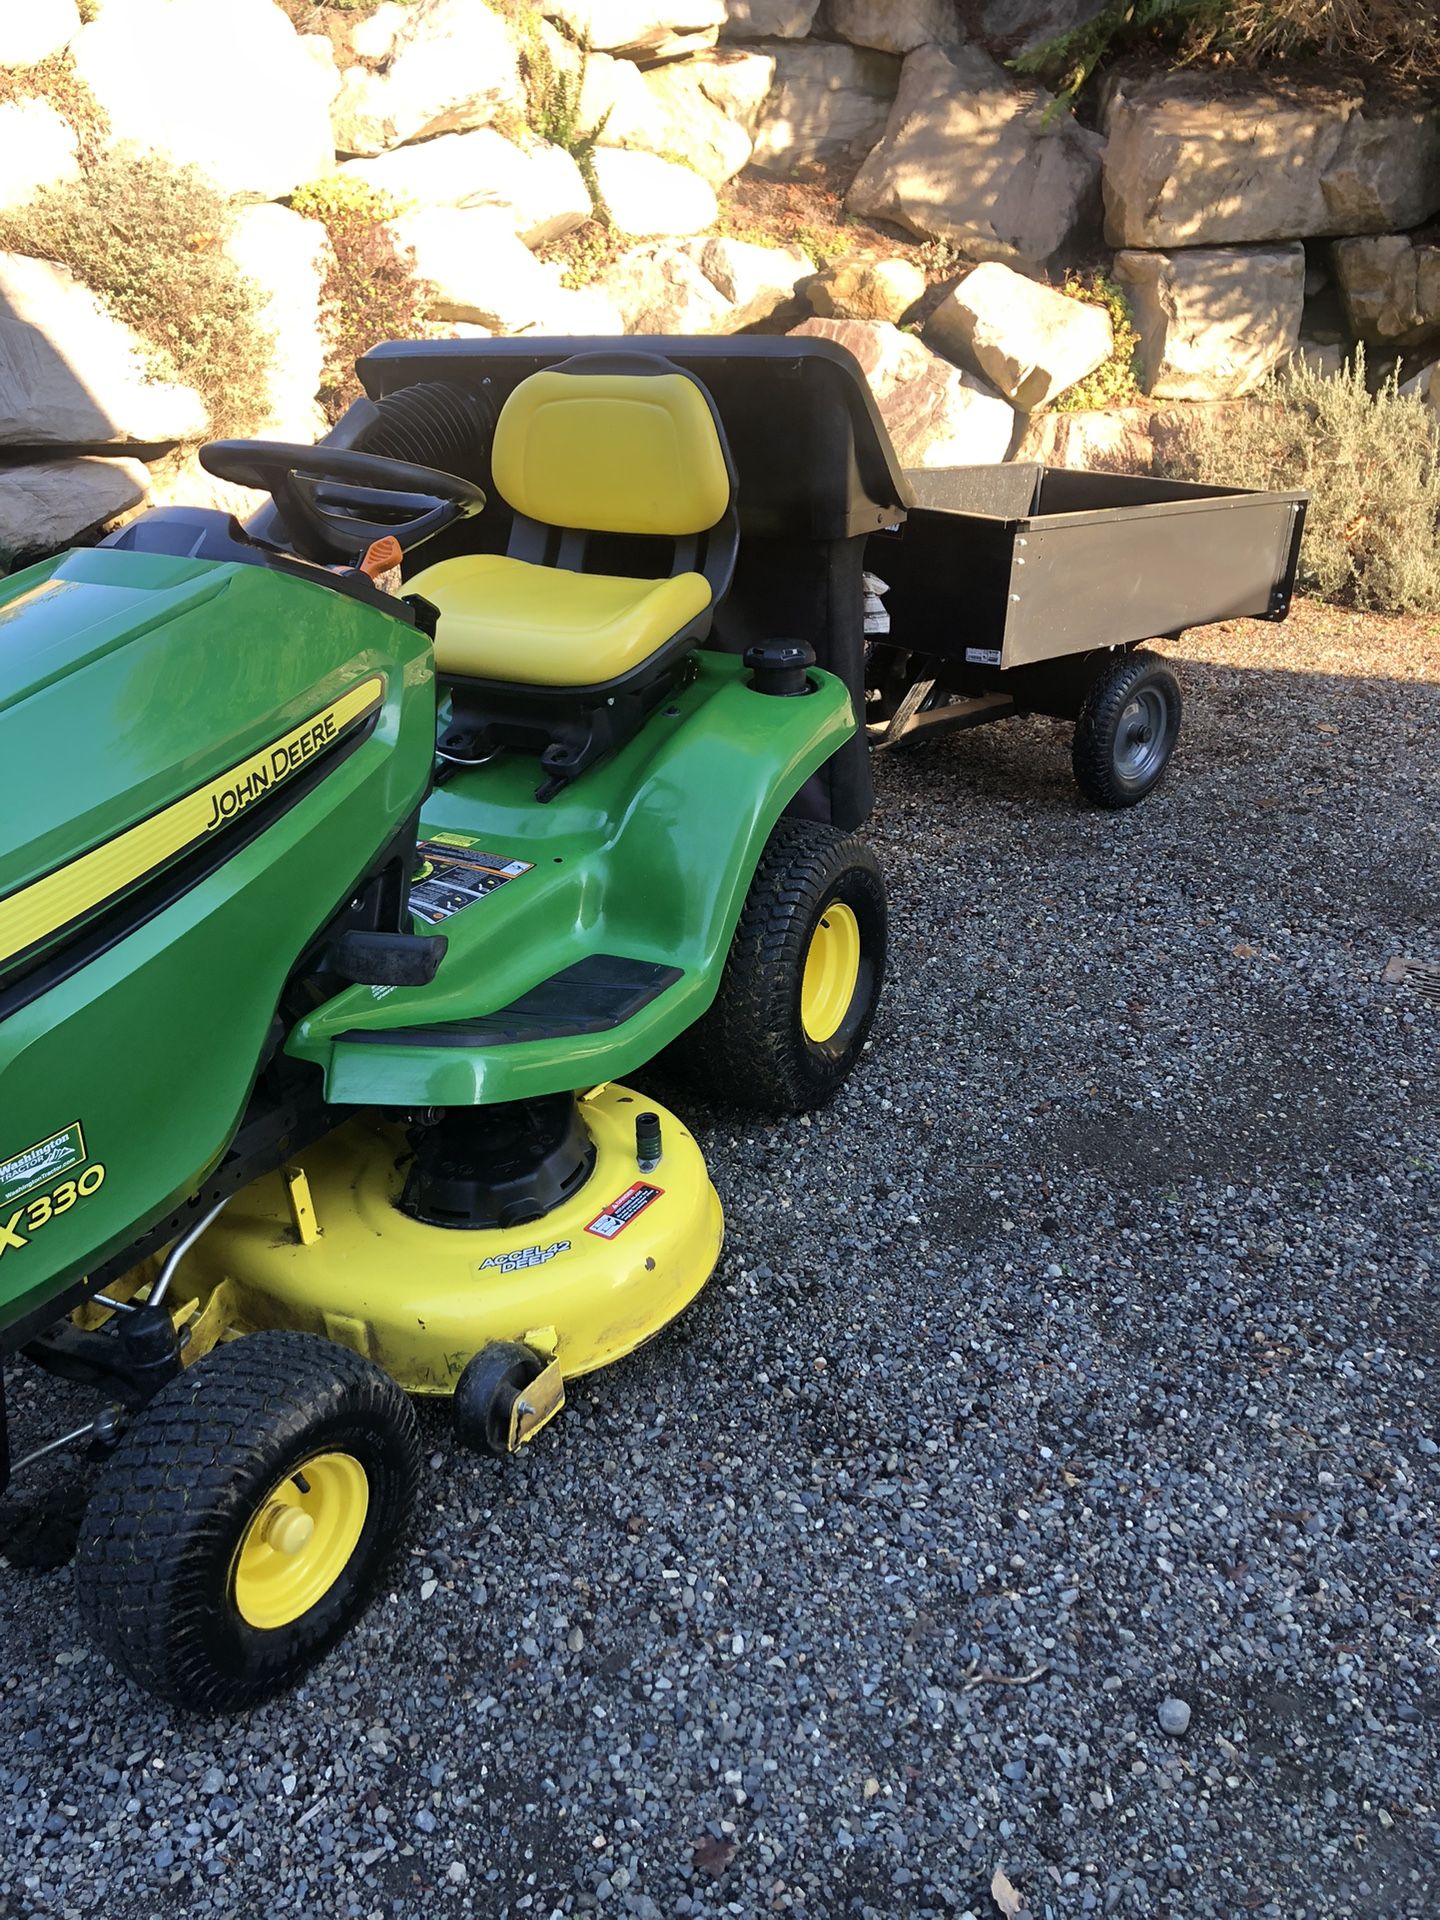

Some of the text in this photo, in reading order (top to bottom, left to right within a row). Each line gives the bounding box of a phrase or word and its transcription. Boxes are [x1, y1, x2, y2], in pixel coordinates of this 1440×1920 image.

[207, 713, 338, 829] JOHN DEERE
[0, 1133, 70, 1177] Washington
[0, 1155, 45, 1183] TRACTOR
[5, 1157, 76, 1199] WashingtonTractor.com
[0, 1163, 106, 1257] X330
[479, 1240, 572, 1270] ACCEL 42
[500, 1252, 555, 1274] DEEP
